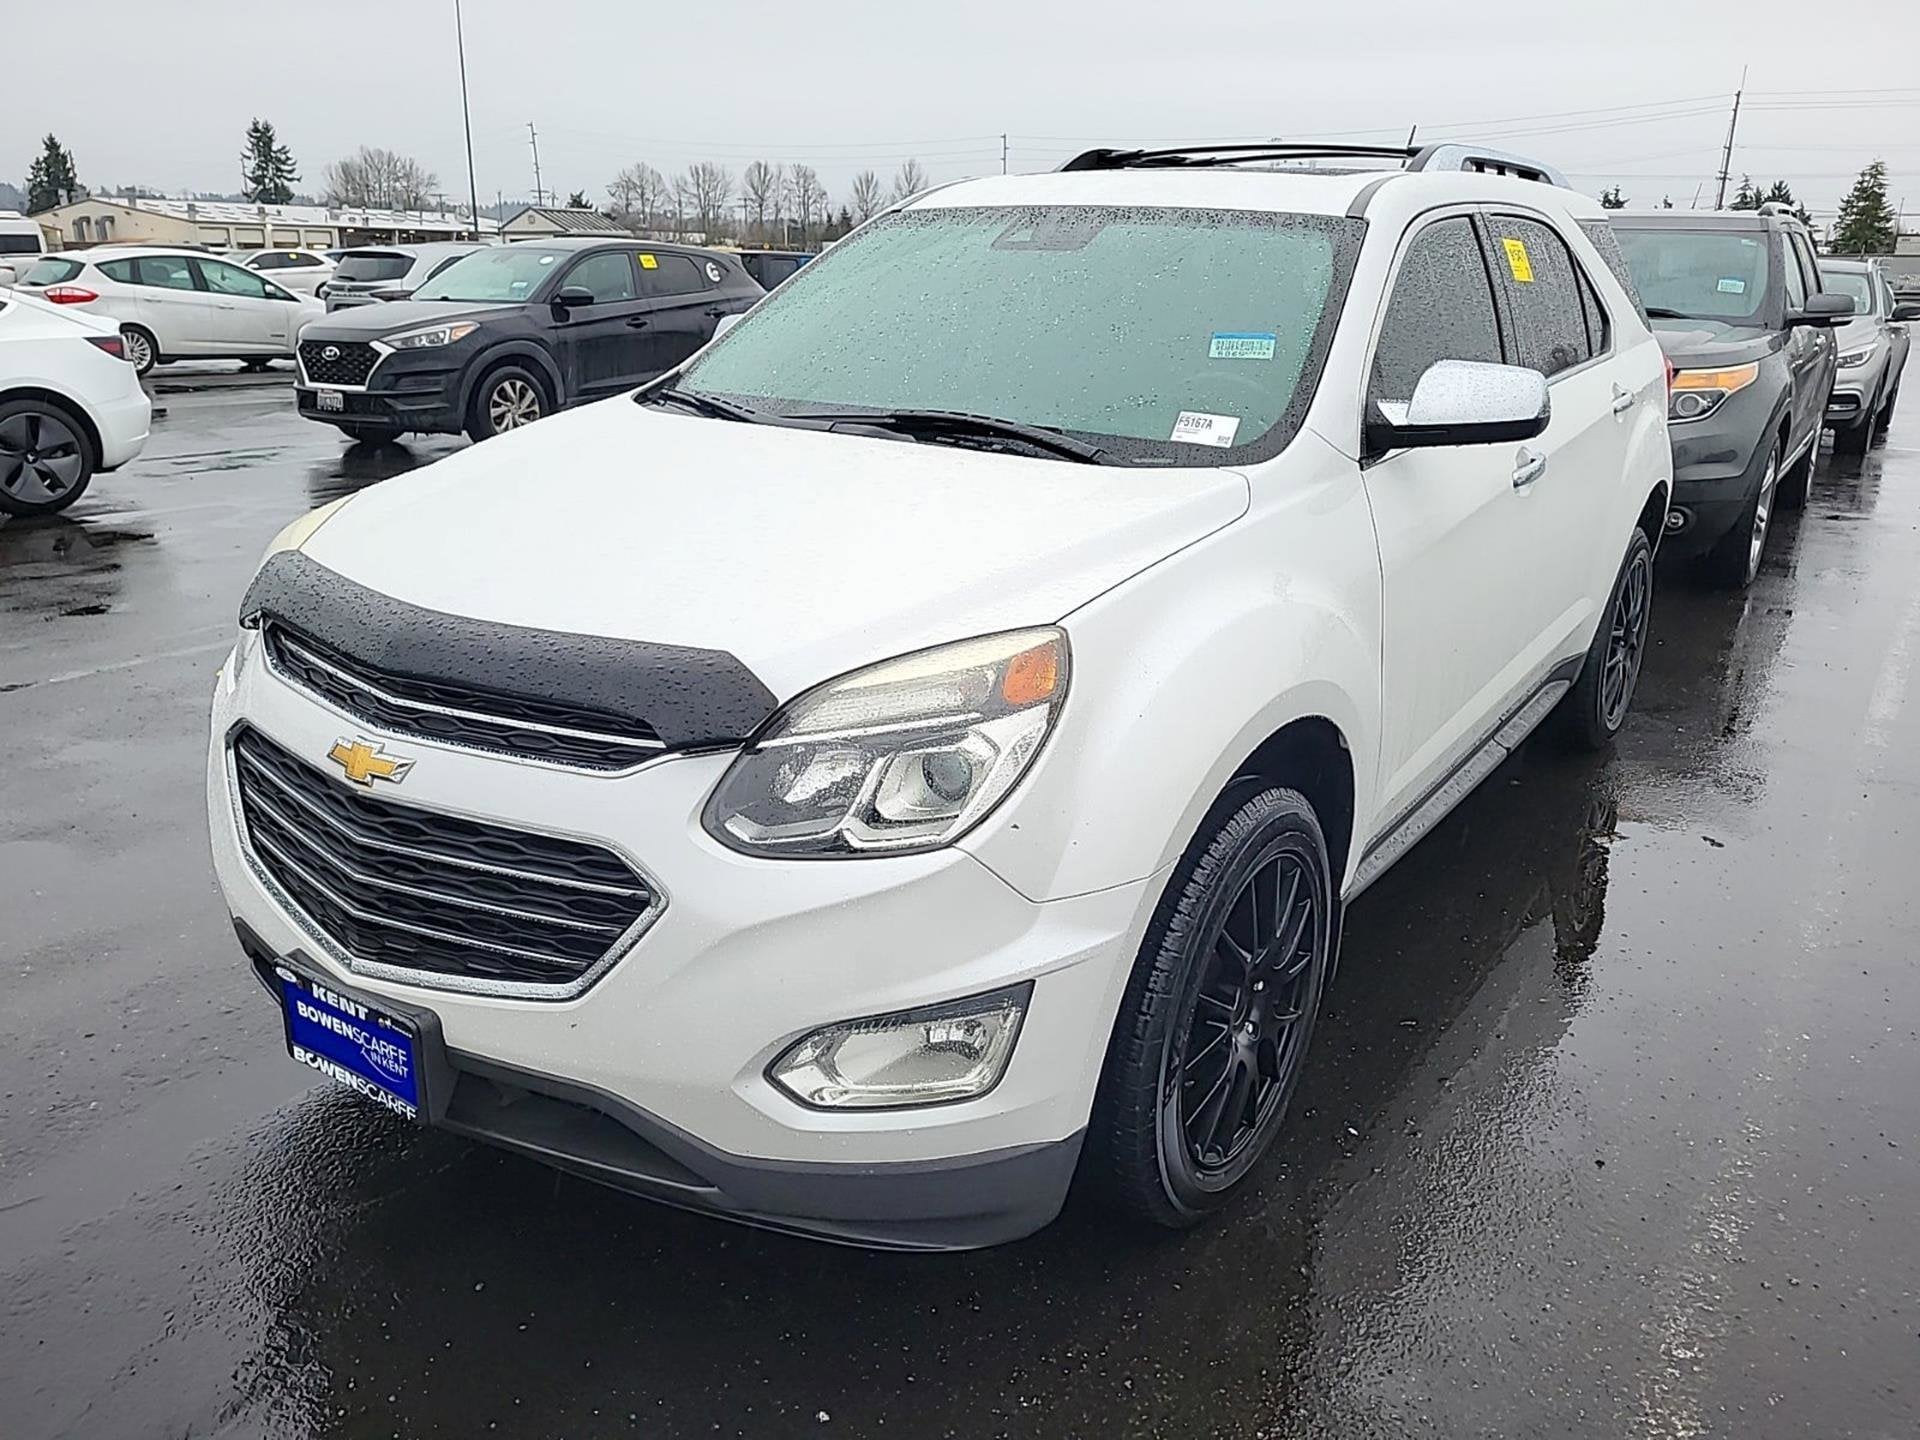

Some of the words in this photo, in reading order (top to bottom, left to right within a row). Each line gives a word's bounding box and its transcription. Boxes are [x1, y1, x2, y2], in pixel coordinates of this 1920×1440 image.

[1177, 415, 1213, 430] F5167A
[311, 982, 369, 1021] KENT
[296, 1000, 408, 1065] BOWENSCARFF
[292, 1045, 417, 1121] BOWENSCARFF
[381, 1057, 409, 1079] KENT
